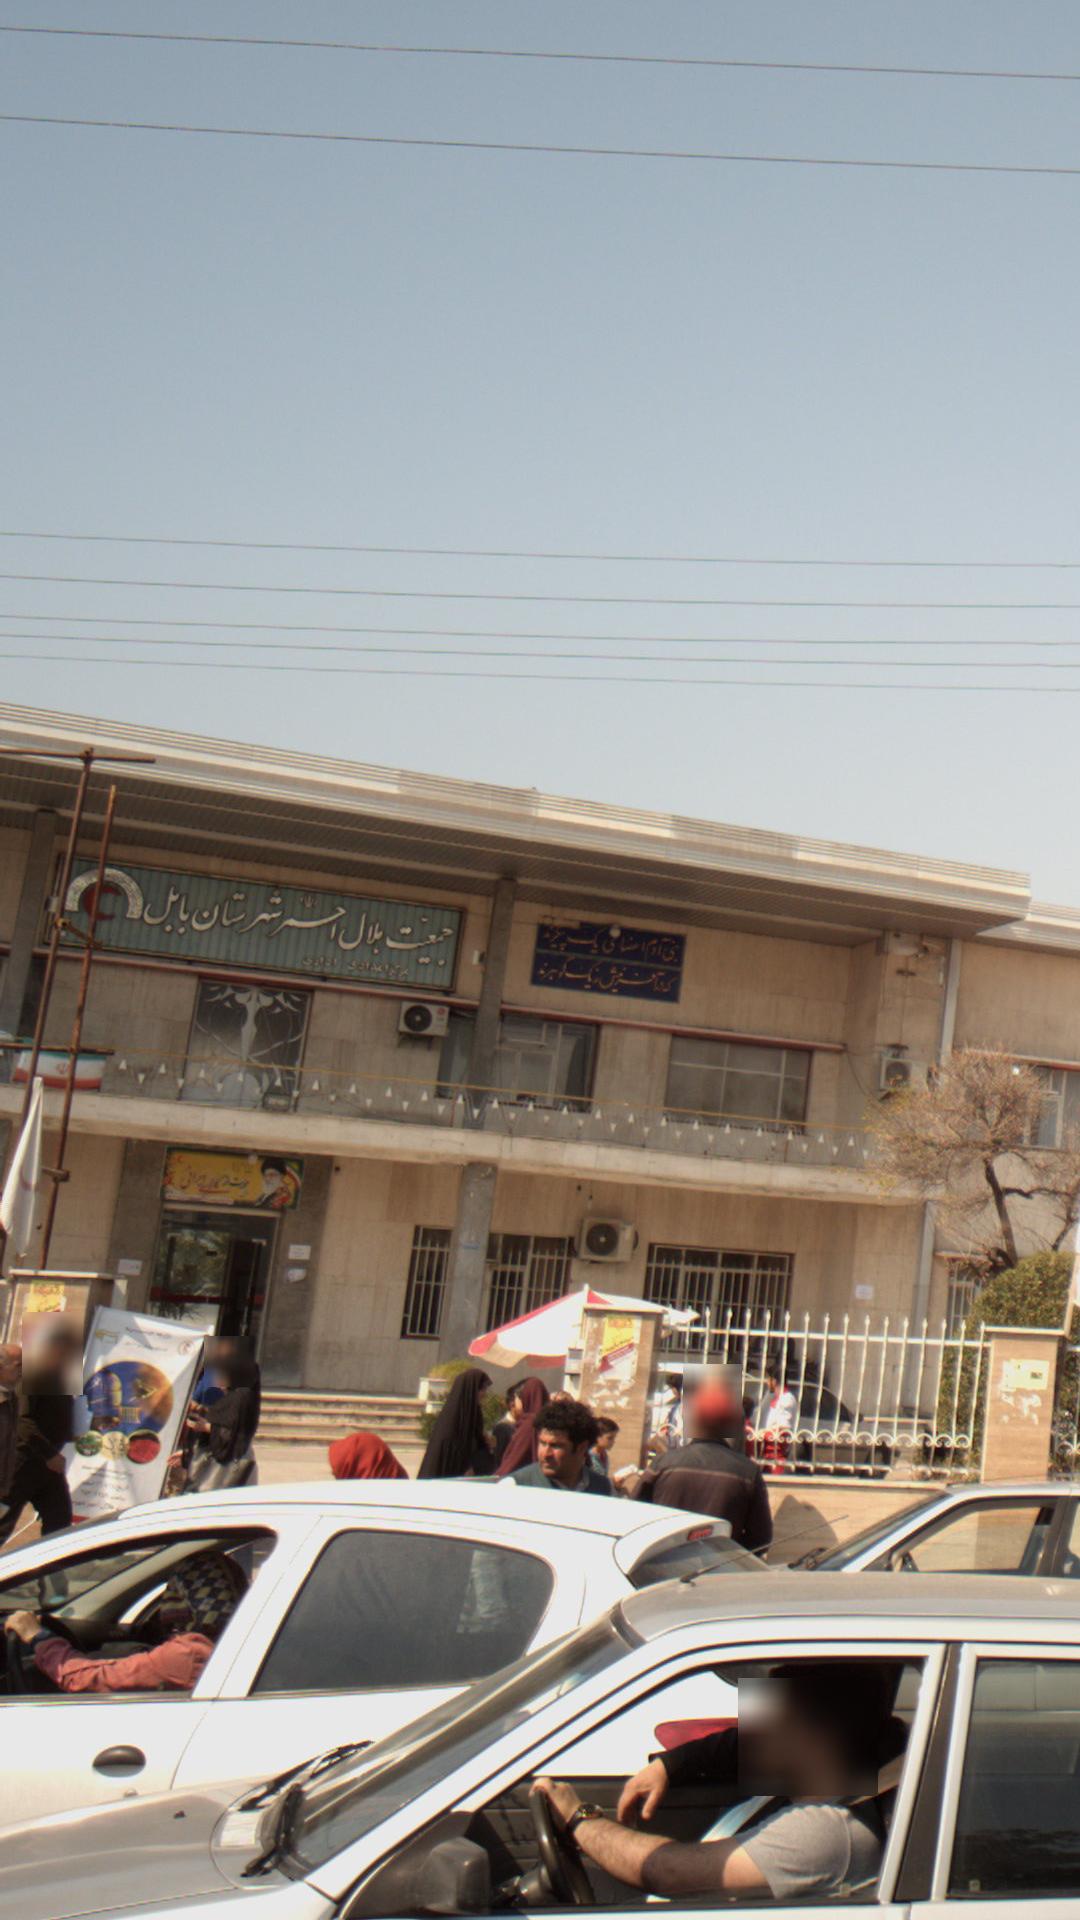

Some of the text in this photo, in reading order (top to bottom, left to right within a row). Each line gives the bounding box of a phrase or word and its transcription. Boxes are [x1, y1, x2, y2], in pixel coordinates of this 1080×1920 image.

[143, 885, 454, 967] جمعیت هلال احمر شهرستان بابل
